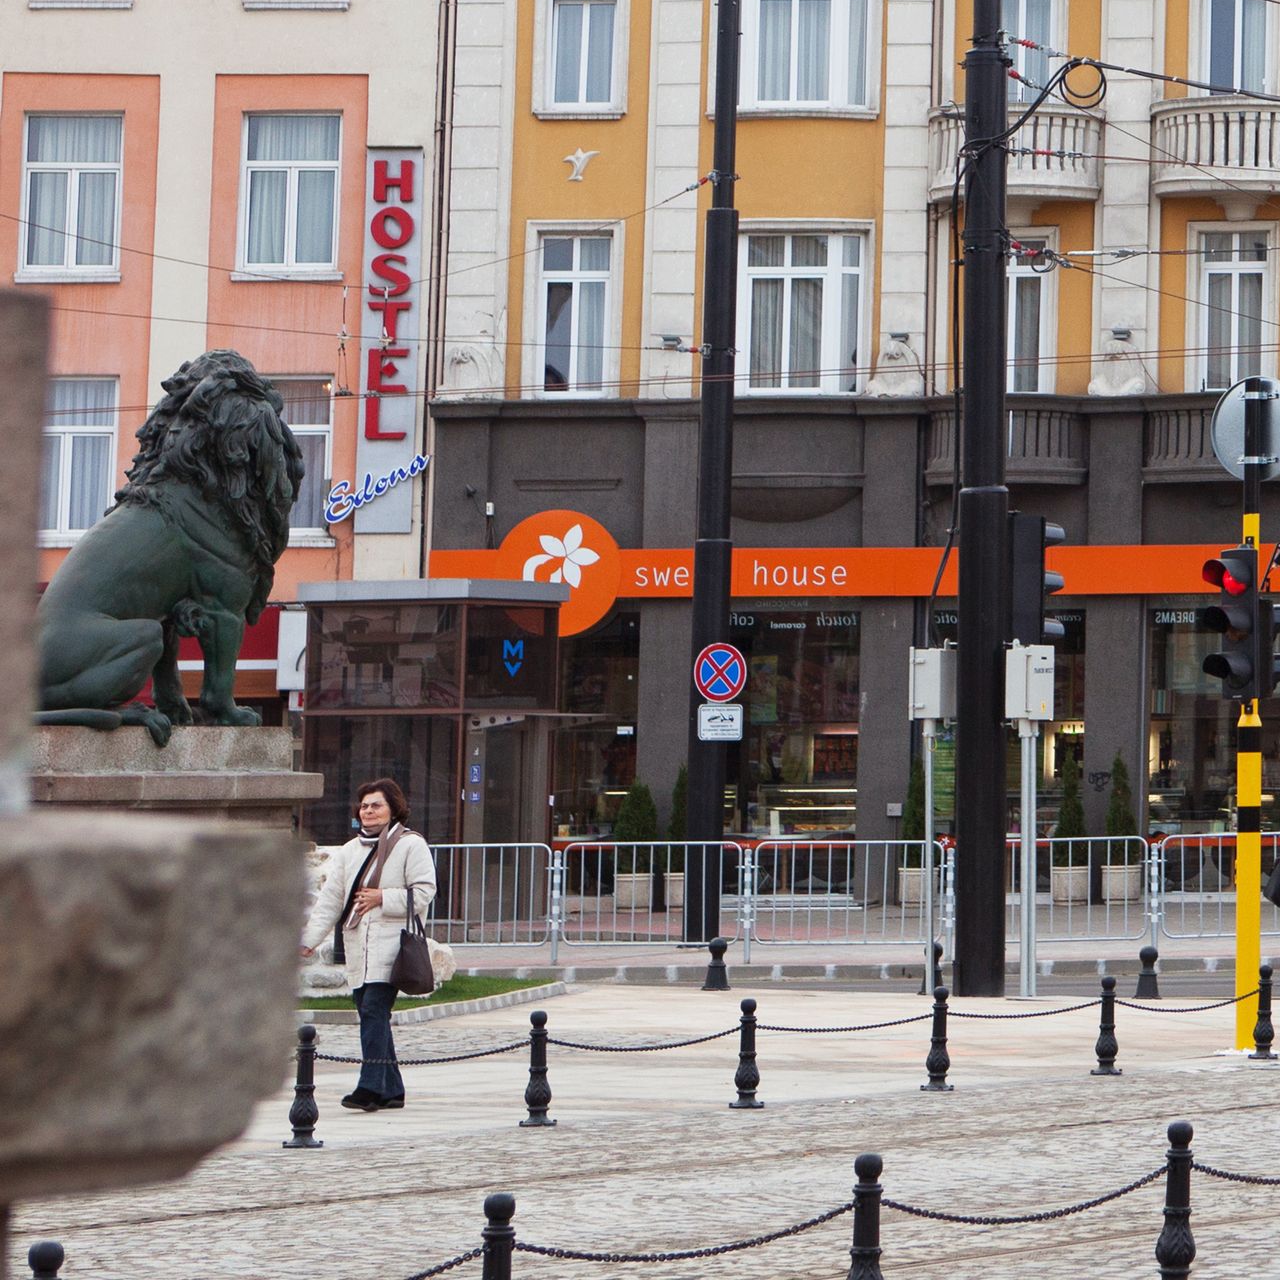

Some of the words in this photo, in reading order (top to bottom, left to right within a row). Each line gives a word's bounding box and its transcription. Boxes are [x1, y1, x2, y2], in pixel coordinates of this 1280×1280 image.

[365, 160, 415, 440] HOSTEL
[325, 454, 432, 523] Edona
[634, 566, 690, 587] swe
[753, 560, 848, 586] house
